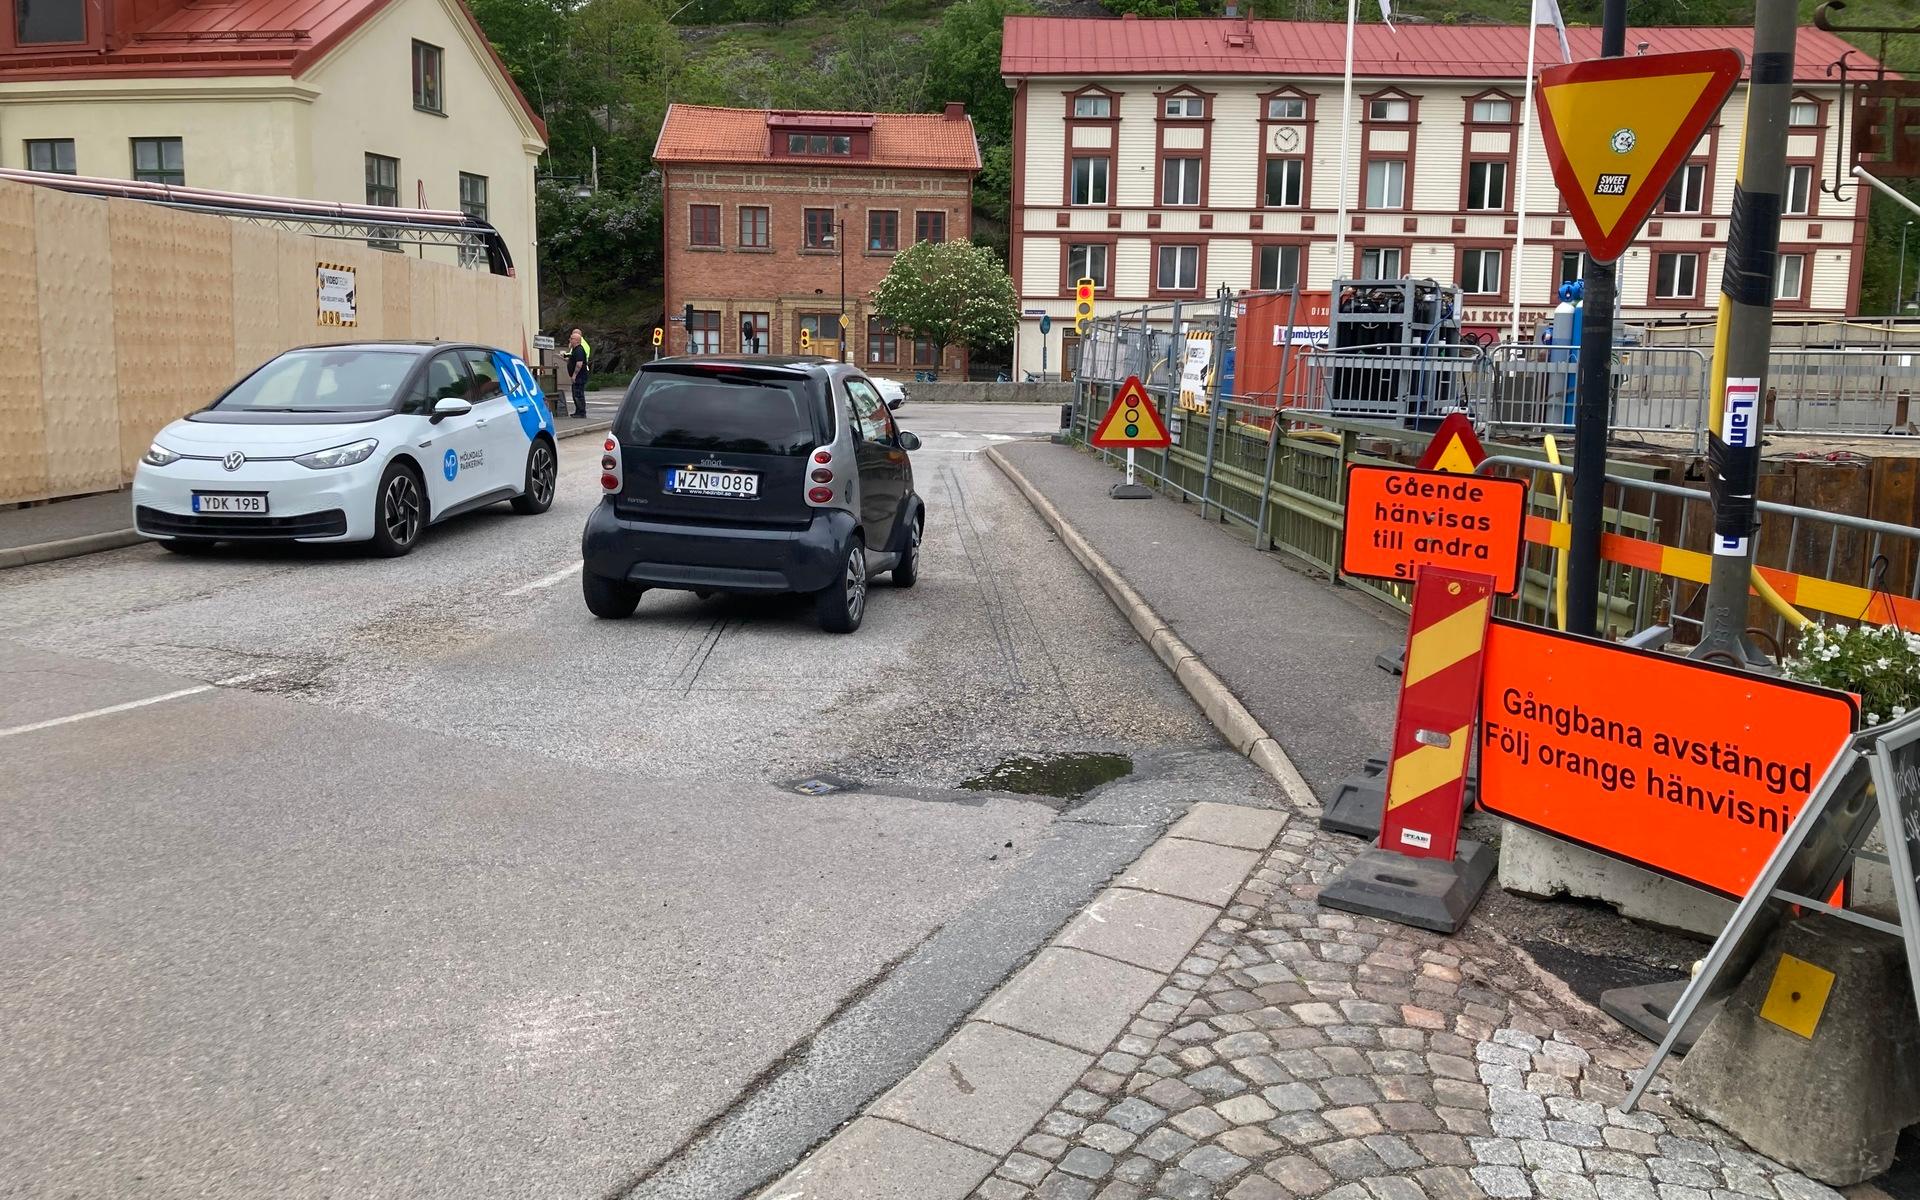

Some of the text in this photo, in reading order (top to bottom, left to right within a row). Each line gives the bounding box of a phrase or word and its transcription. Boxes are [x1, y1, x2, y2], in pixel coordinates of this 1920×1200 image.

[1600, 175, 1627, 185] SWEET
[1461, 311, 1477, 322] AI
[678, 472, 753, 492] WZN 086
[1385, 475, 1484, 503] Gående
[203, 497, 260, 510] YDK 19B
[1375, 502, 1491, 531] hänvisas
[1373, 529, 1489, 560] till andra
[1394, 559, 1415, 579] si
[1503, 688, 1812, 795] Gångbana avstängd
[1485, 721, 1792, 835] Följ orange hänvisni
